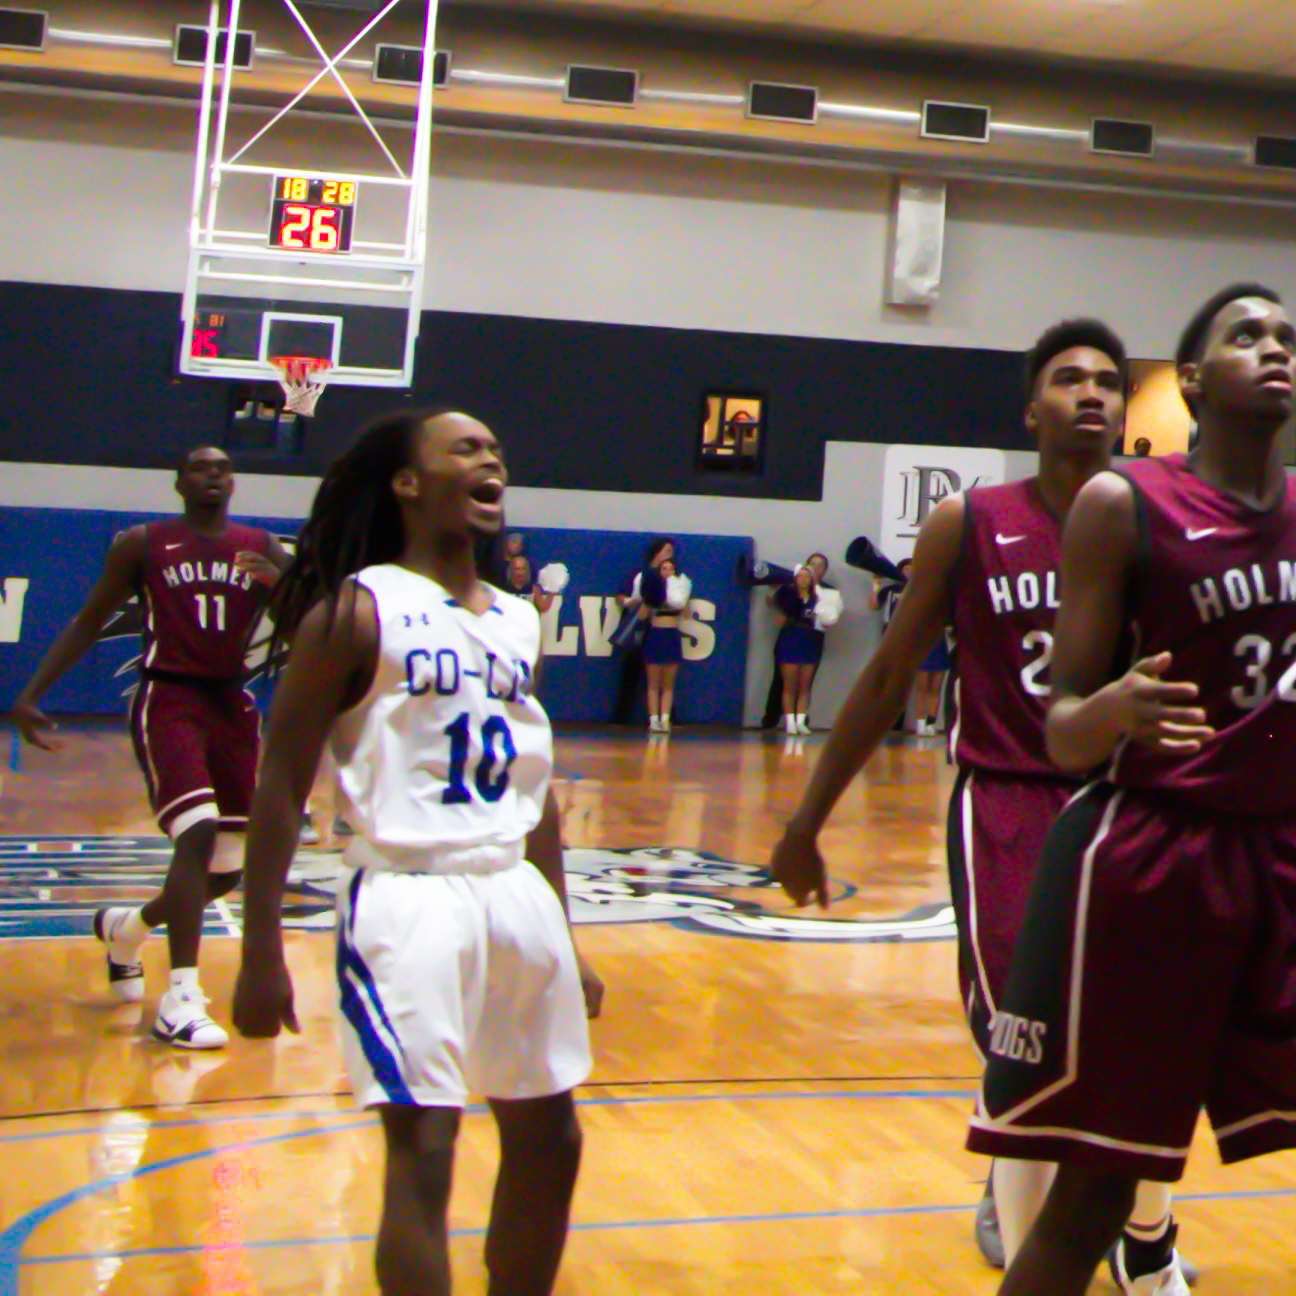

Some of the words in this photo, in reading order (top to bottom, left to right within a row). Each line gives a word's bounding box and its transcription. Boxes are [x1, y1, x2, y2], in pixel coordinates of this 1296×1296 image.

[283, 178, 307, 201] 18
[322, 181, 355, 205] 28
[281, 206, 338, 251] 26
[194, 594, 226, 631] 11
[1021, 630, 1054, 696] 2
[442, 712, 518, 805] 10
